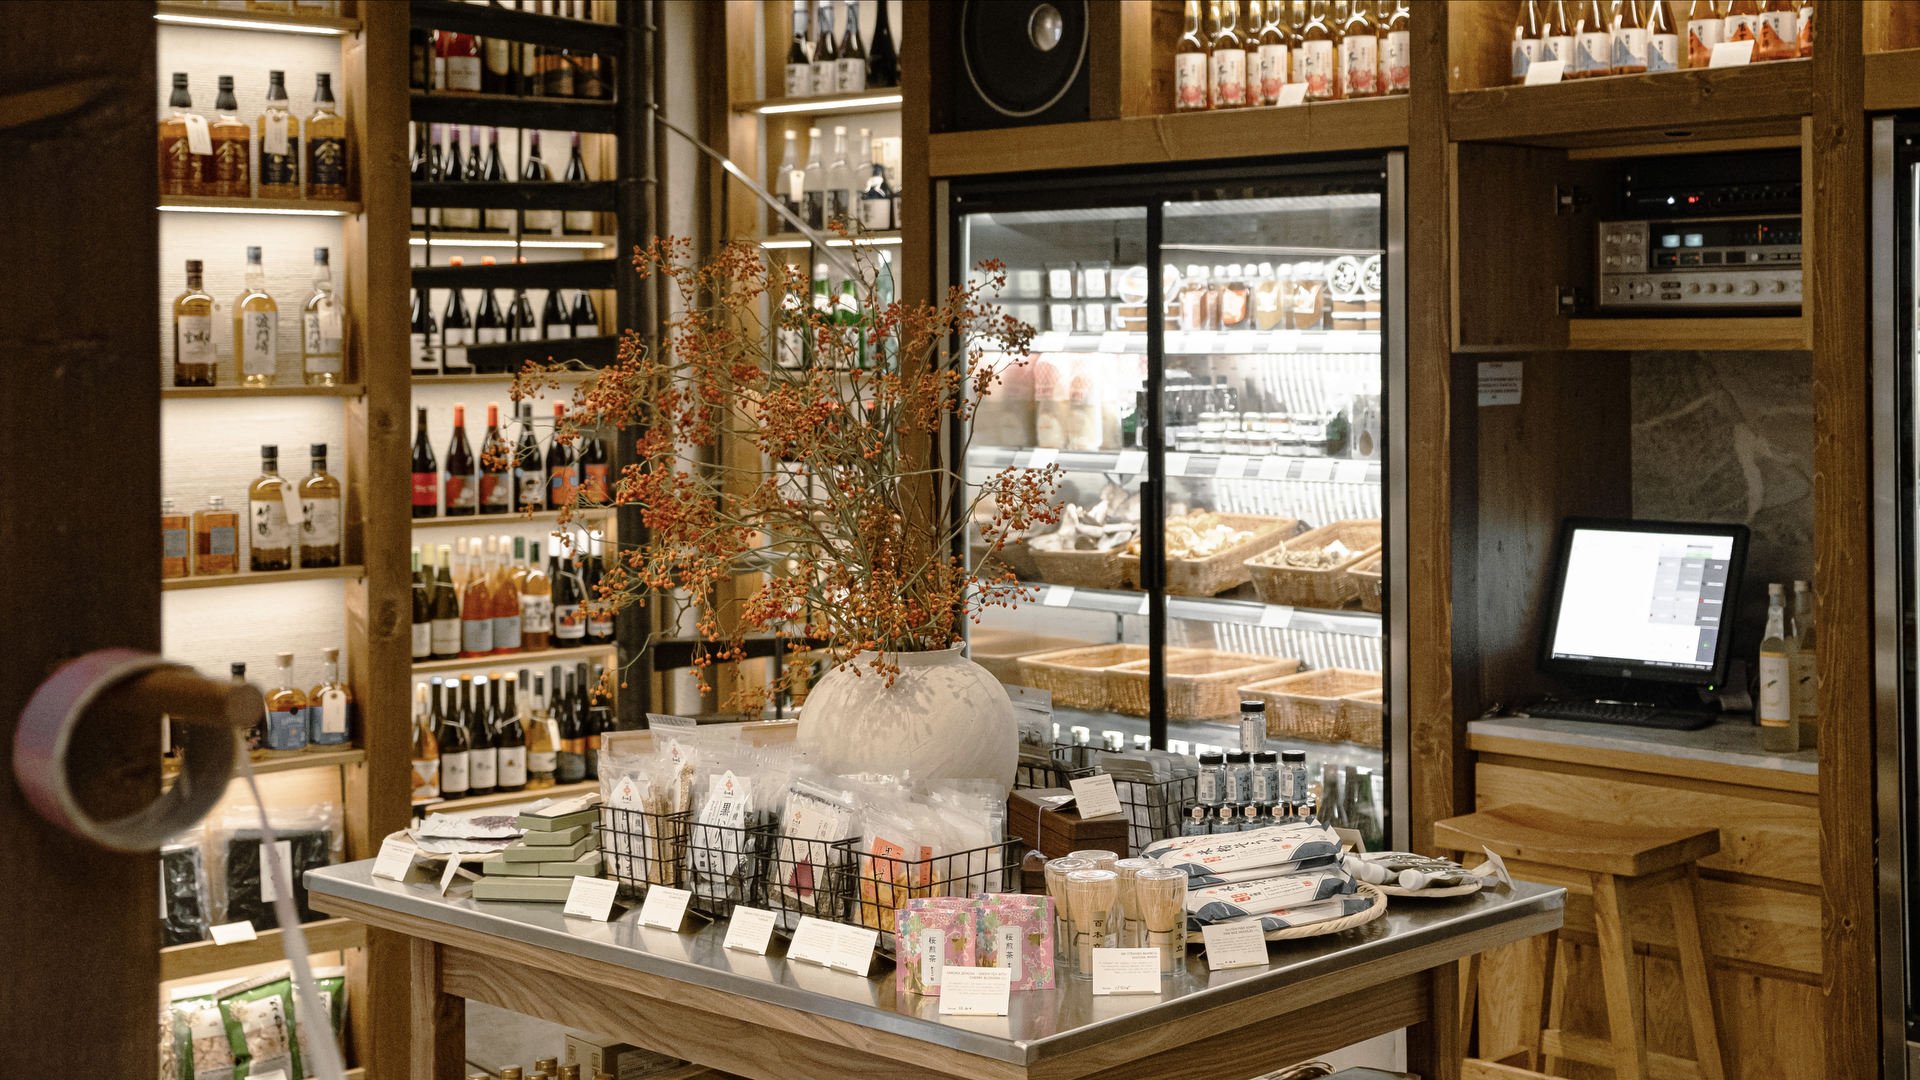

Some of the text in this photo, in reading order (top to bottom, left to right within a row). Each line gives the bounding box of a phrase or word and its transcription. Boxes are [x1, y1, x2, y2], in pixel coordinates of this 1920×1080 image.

[928, 936, 937, 963] 桜煎茶
[1005, 932, 1015, 959] 桜煎茶
[1175, 921, 1185, 953] 百本立
